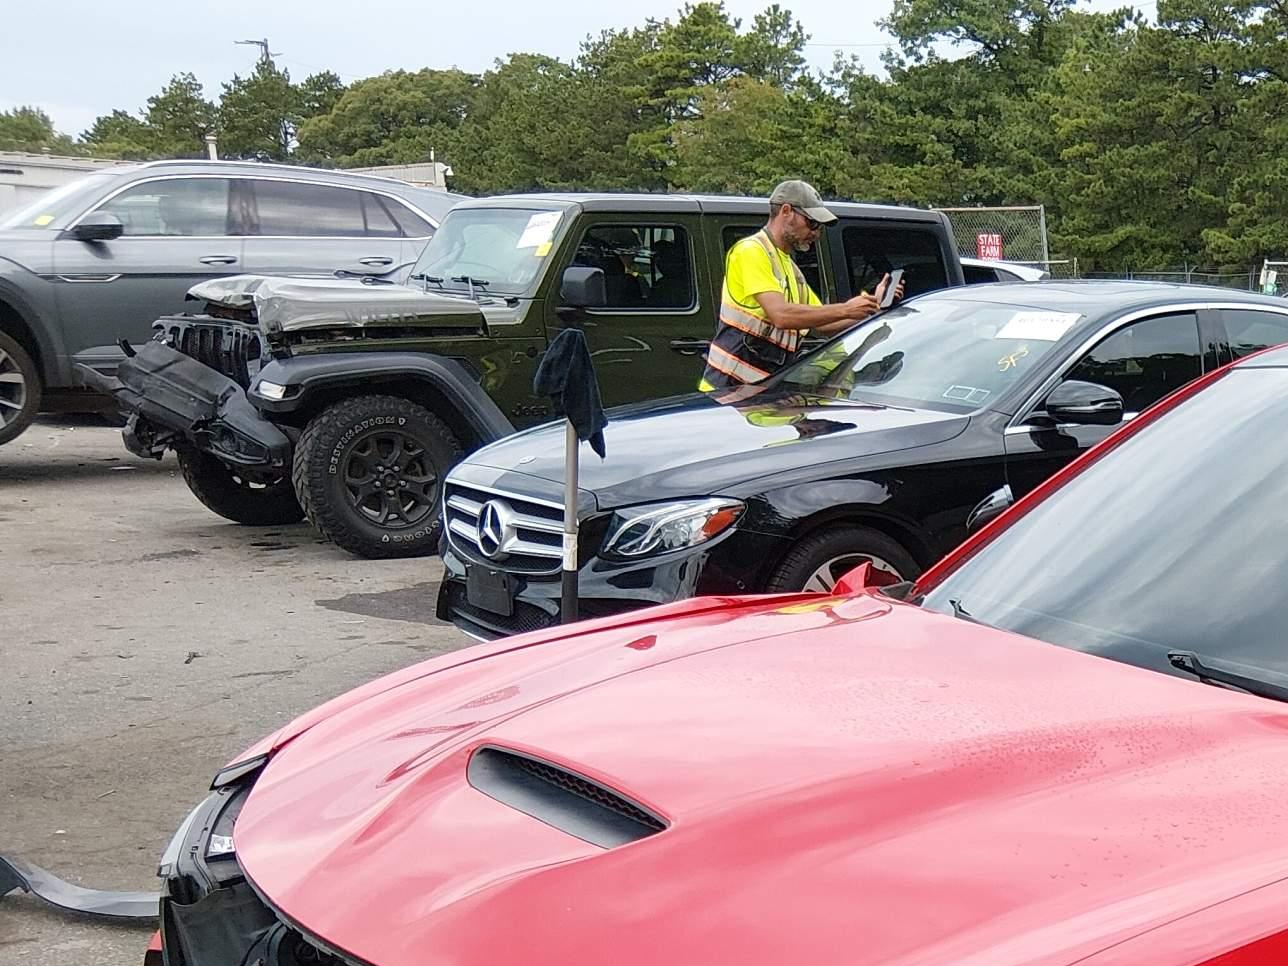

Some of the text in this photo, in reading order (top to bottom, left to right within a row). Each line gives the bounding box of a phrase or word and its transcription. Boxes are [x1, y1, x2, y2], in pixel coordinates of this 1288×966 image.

[978, 233, 1000, 245] STATE
[980, 245, 1000, 257] FARM
[329, 416, 396, 474] DESTINATION
